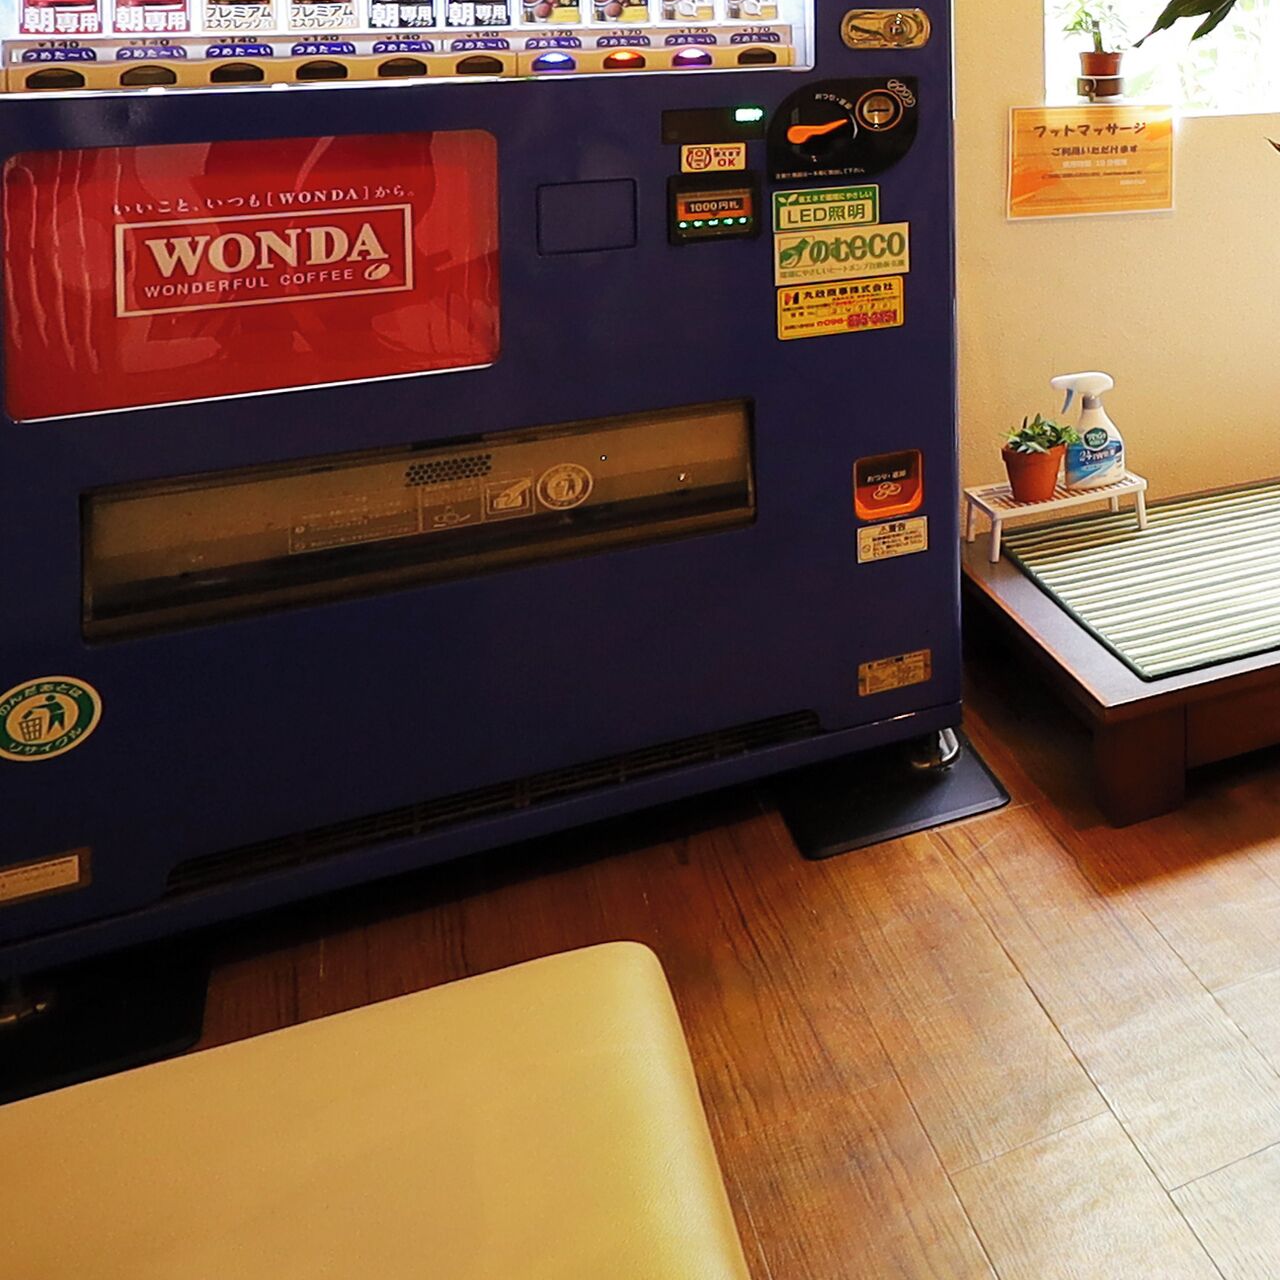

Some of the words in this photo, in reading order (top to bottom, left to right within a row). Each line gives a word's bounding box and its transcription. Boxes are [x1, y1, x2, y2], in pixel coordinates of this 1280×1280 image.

[24, 6, 98, 33] 朝専用
[116, 6, 186, 32] 朝専用
[1033, 122, 1146, 138] フットマッサージ
[717, 158, 736, 167] OK
[690, 201, 739, 212] 1000円札
[787, 203, 865, 224] LED照明
[145, 223, 390, 279] WONDA
[144, 276, 270, 298] WONDERFUL
[280, 269, 353, 286] COFFEE
